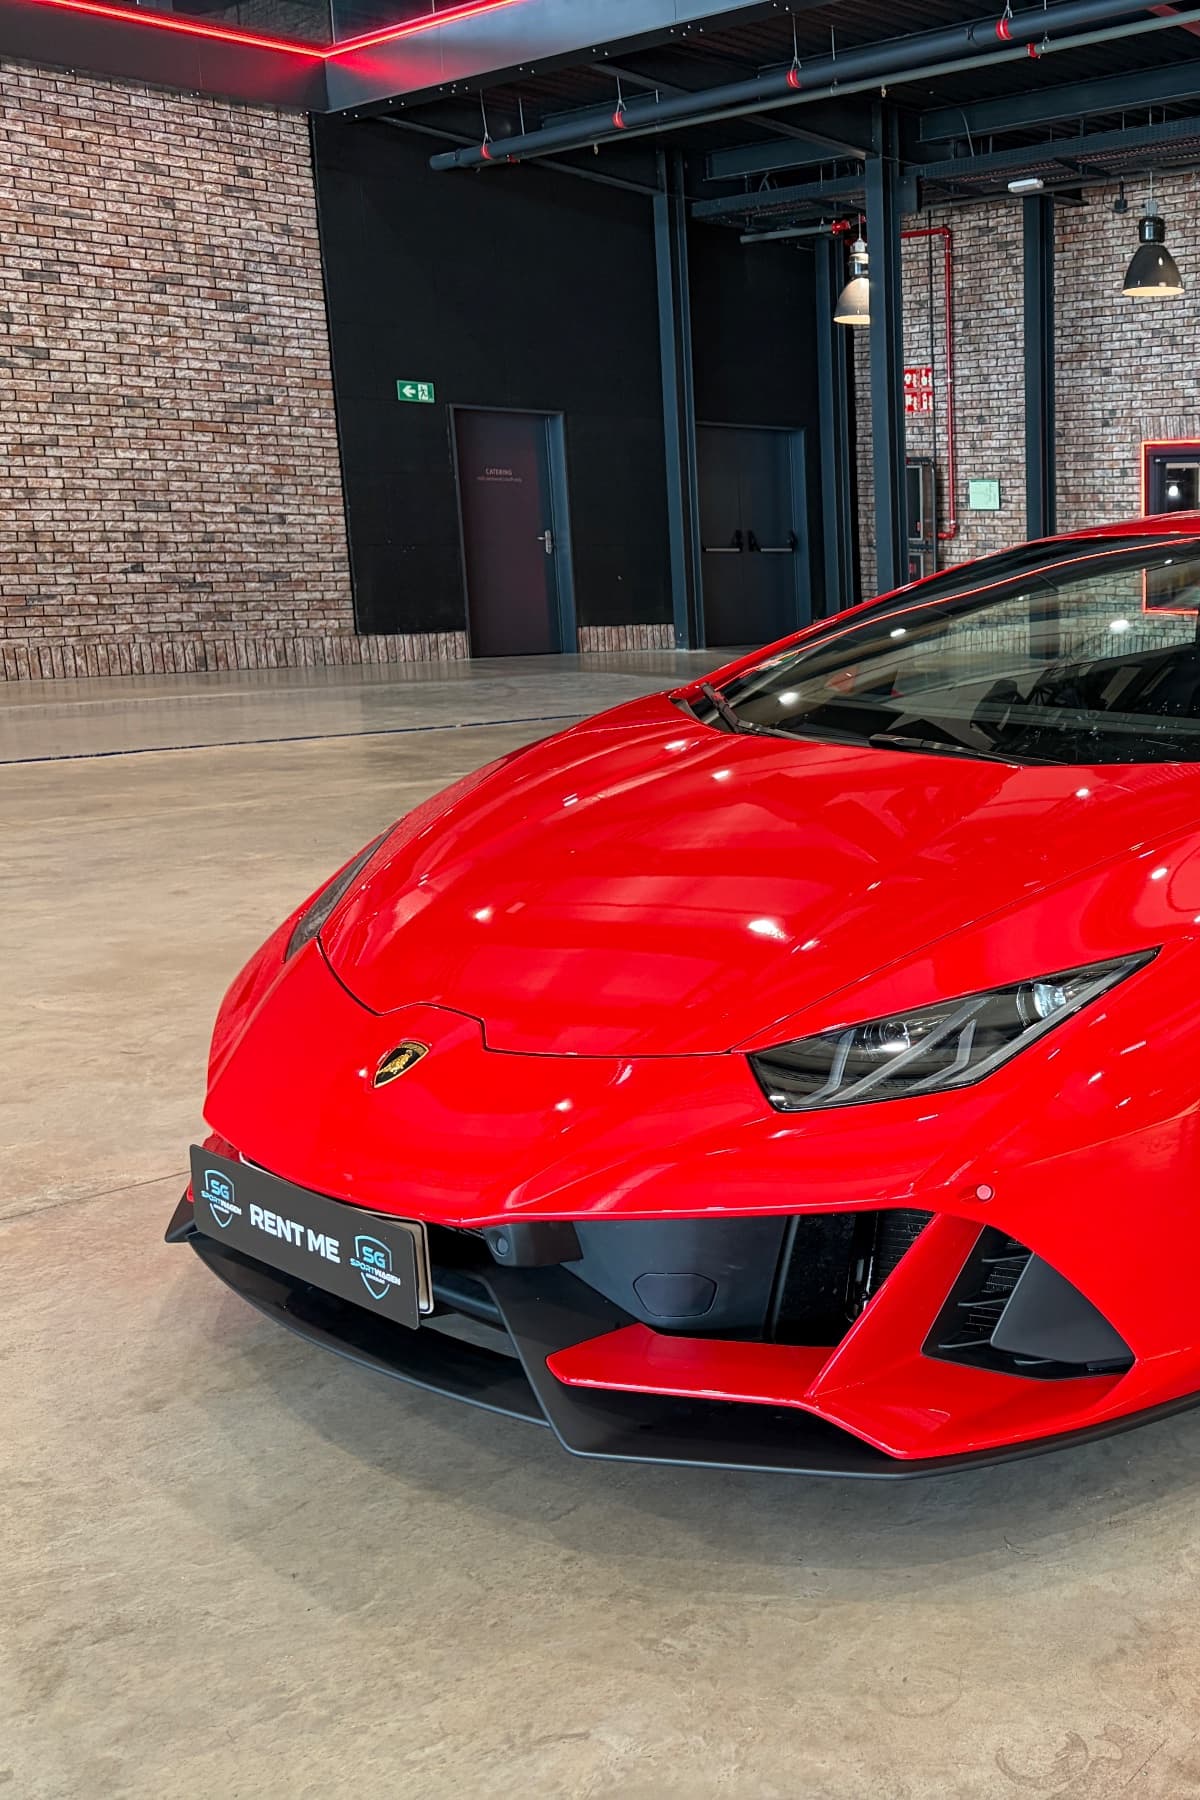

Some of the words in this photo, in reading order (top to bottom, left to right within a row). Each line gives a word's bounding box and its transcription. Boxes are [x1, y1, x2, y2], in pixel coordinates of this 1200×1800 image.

[210, 1179, 230, 1200] SG
[249, 1203, 304, 1247] RENT
[307, 1228, 341, 1264] ME
[362, 1246, 386, 1269] SG
